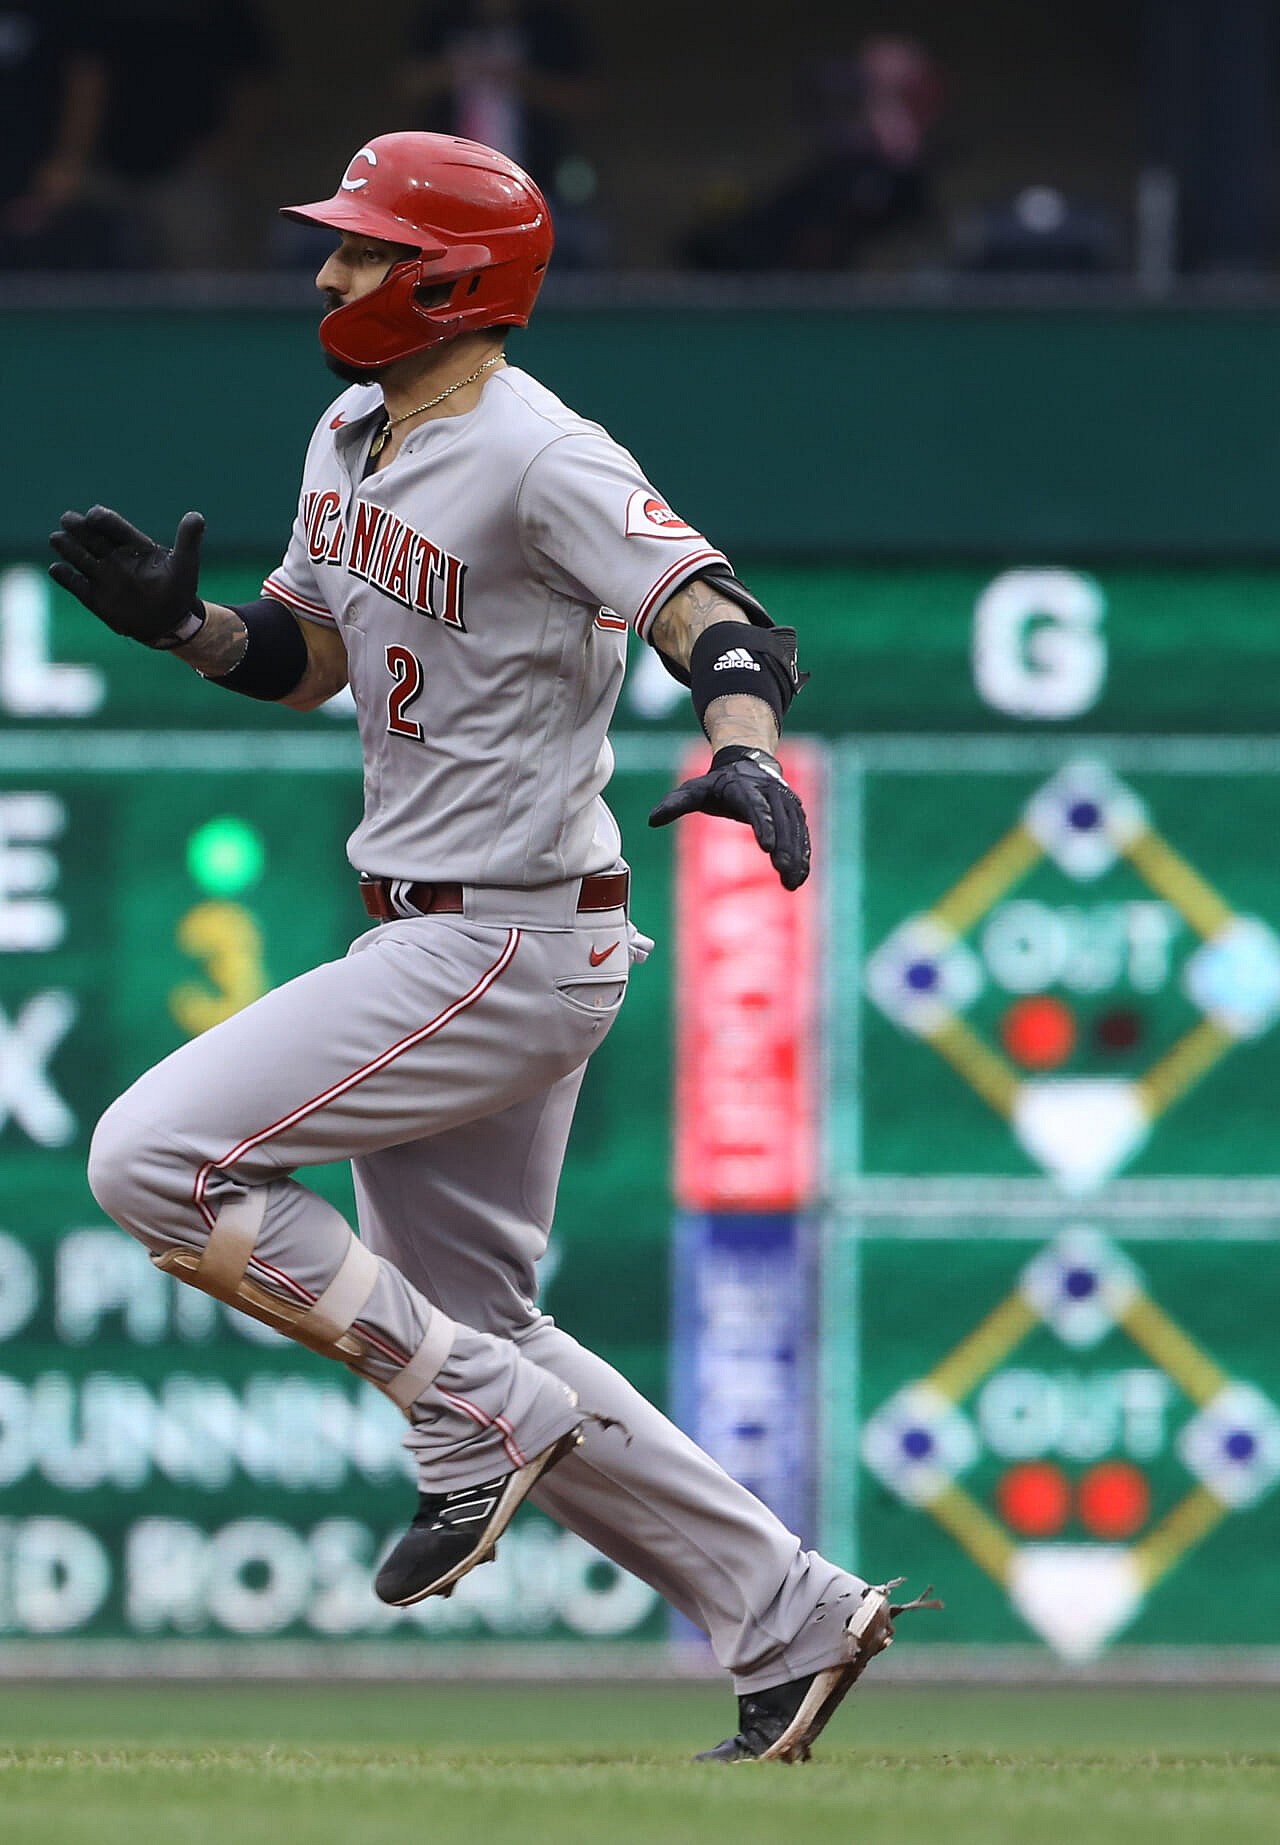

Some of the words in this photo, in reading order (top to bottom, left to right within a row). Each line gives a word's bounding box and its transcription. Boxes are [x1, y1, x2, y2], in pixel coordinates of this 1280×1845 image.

[341, 147, 377, 190] C
[384, 644, 425, 742] 2
[713, 659, 761, 672] adidas
[167, 900, 266, 1041] 3
